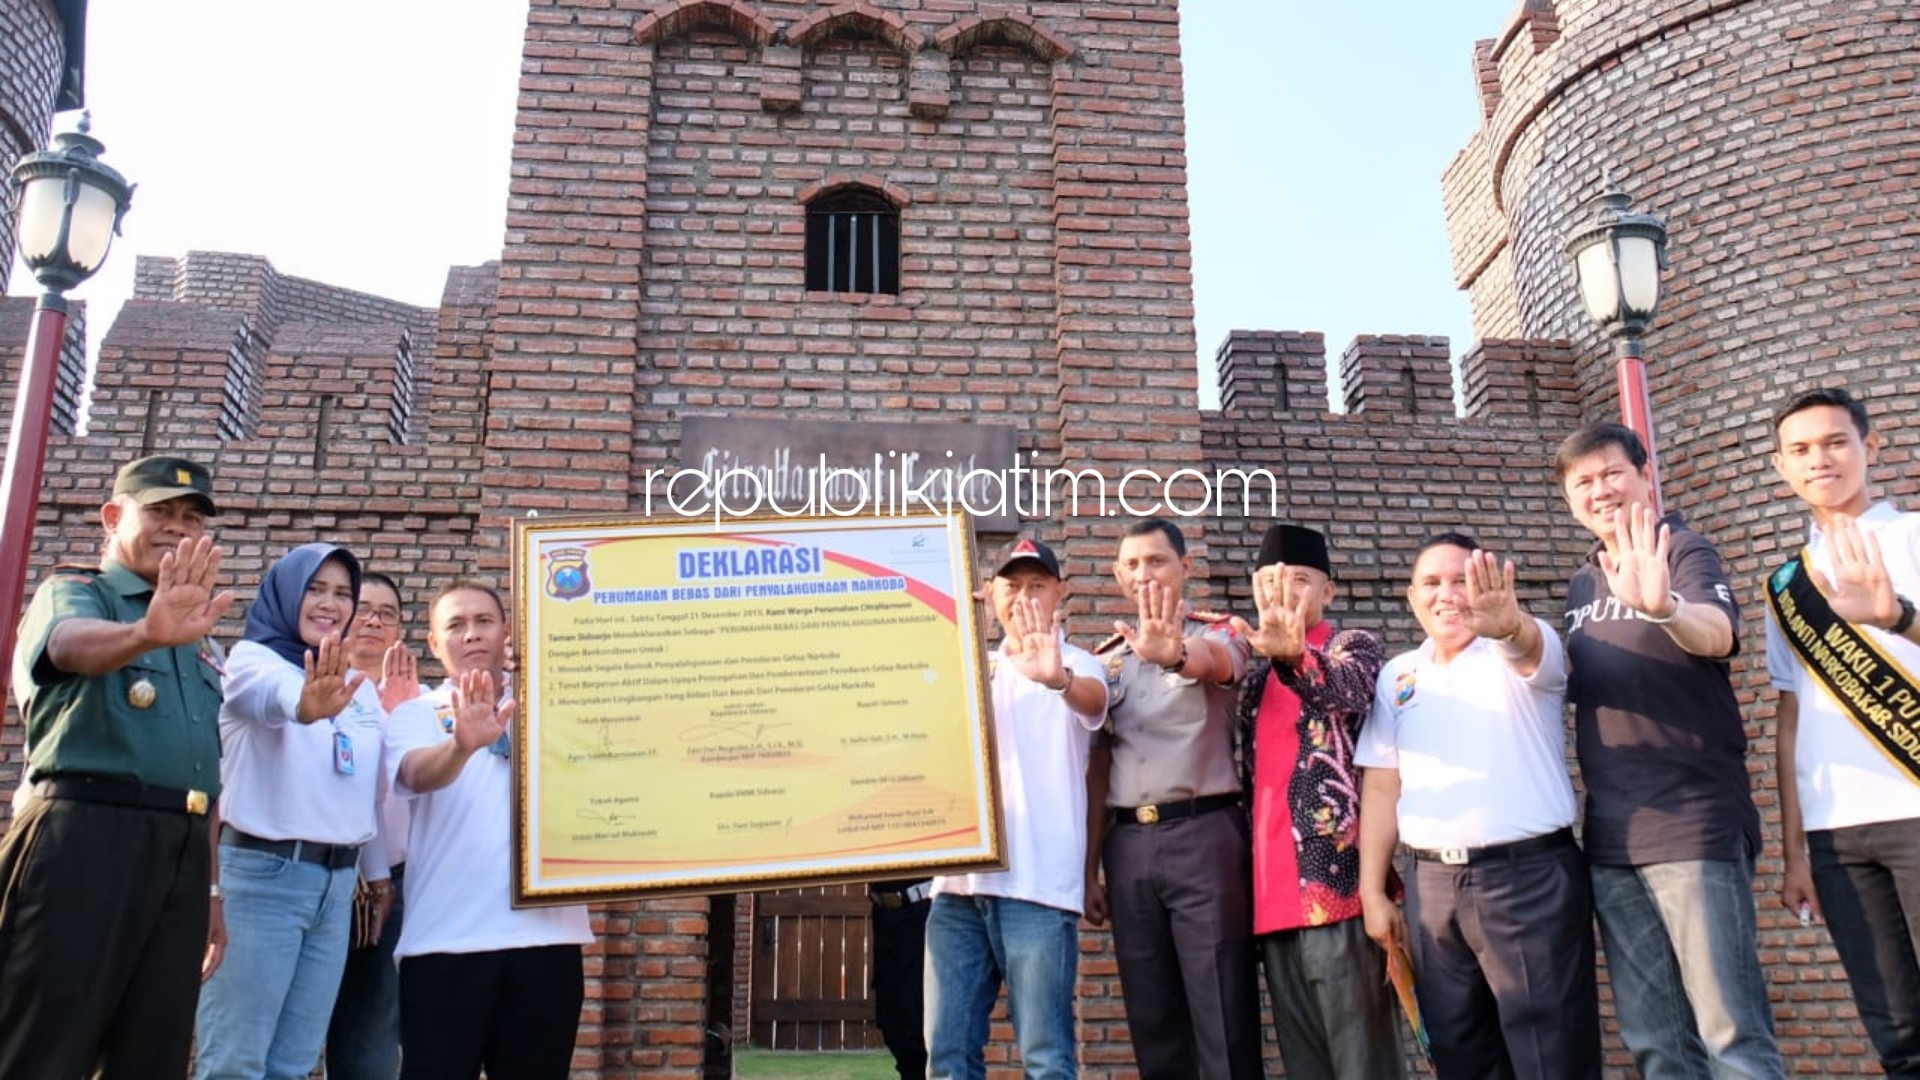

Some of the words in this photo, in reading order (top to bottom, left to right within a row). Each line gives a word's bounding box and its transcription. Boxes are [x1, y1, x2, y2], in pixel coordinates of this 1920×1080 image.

[679, 546, 820, 579] DEKLARASI
[594, 589, 668, 604] PERUMAHAN
[672, 587, 710, 601] BEBAS
[714, 585, 742, 599] DARI
[745, 580, 848, 598] PENYALAHGUNAAN
[851, 577, 905, 594] NARKOBA
[788, 607, 813, 616] Warga
[815, 604, 859, 614] Perumahan
[549, 634, 577, 642] Taman
[1809, 640, 1865, 705] NARKOBA
[1859, 693, 1892, 731] KAB.
[1824, 622, 1878, 684] WAKIL
[1873, 673, 1896, 697] 1
[1888, 688, 1920, 731] PU
